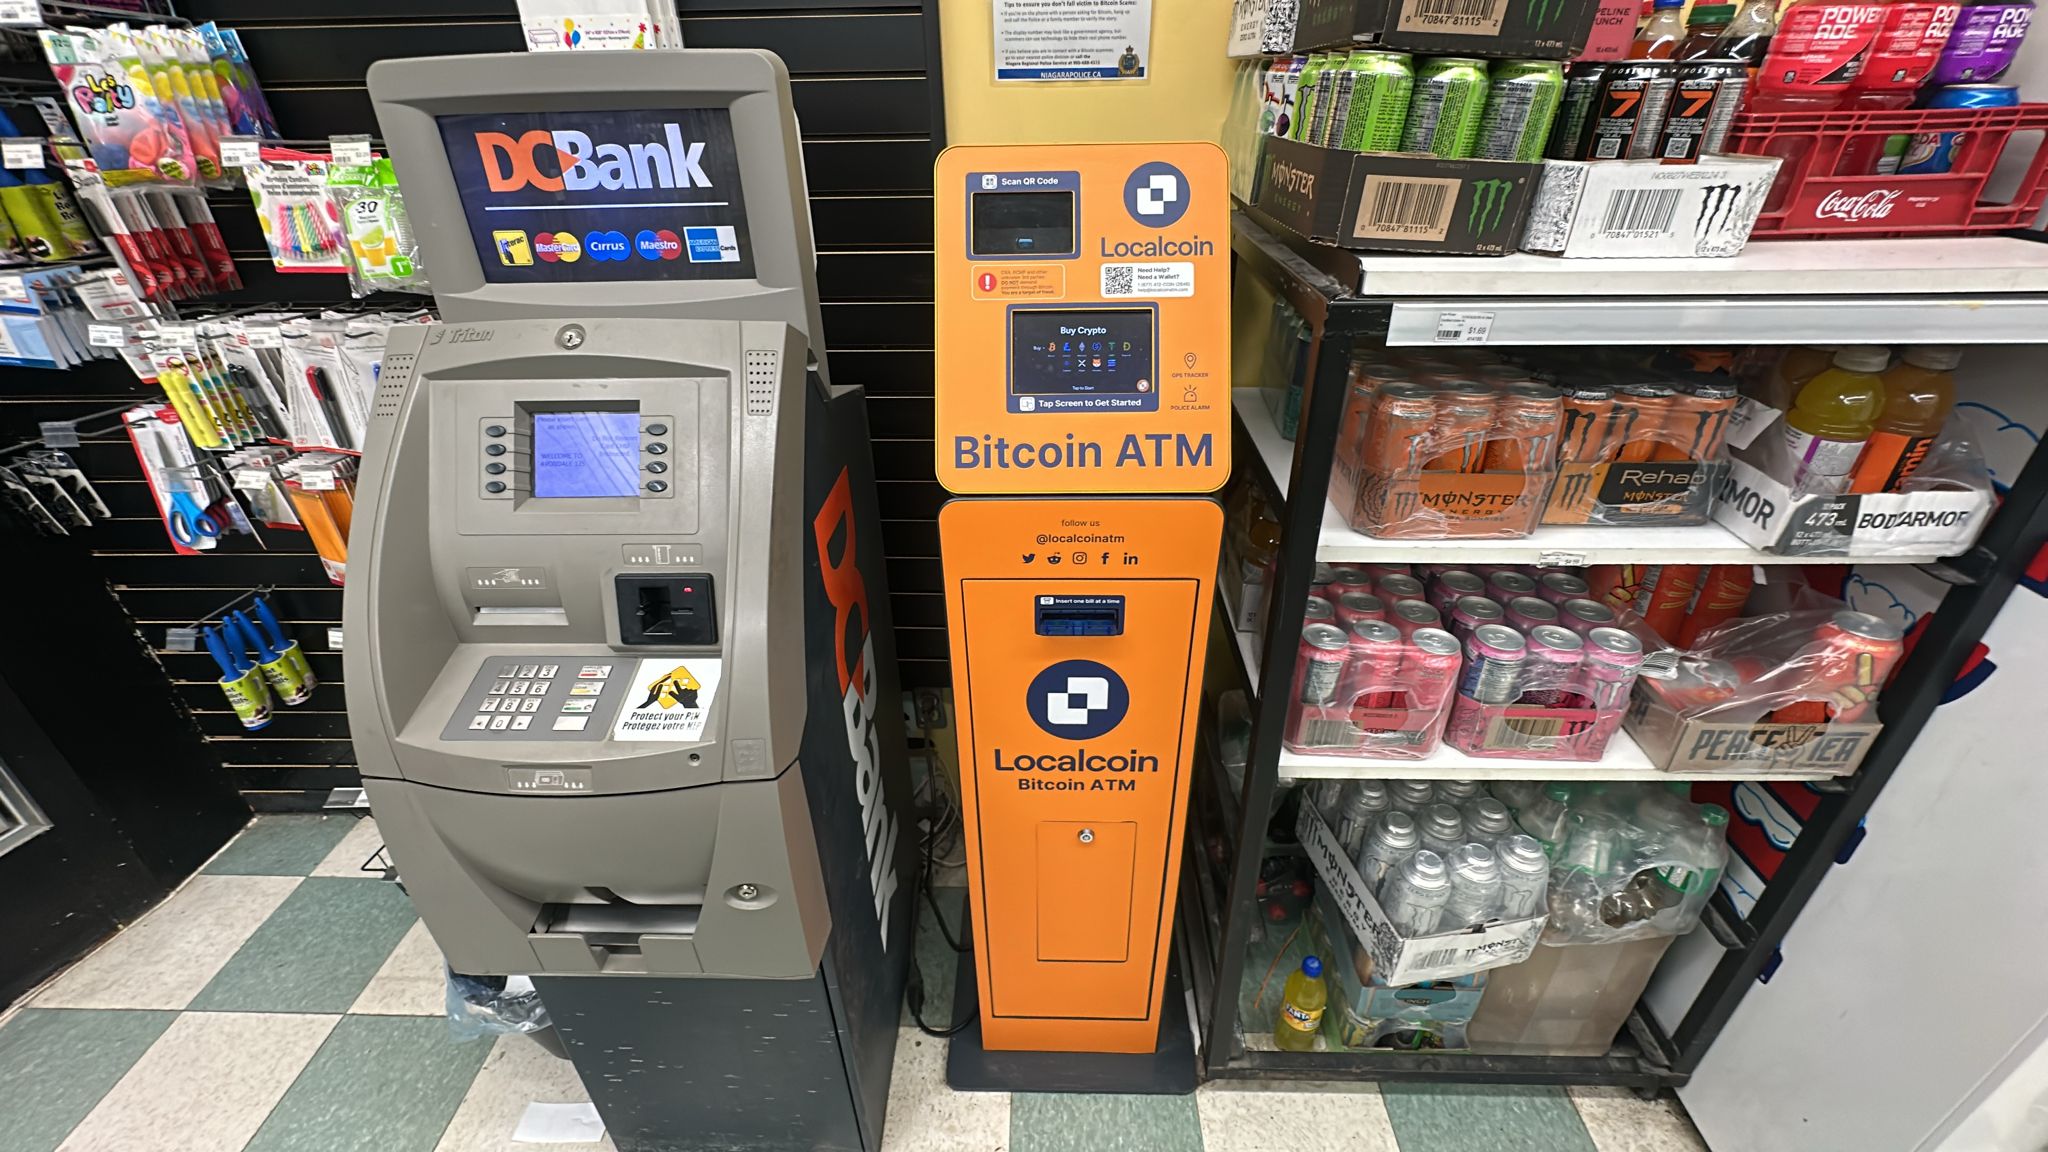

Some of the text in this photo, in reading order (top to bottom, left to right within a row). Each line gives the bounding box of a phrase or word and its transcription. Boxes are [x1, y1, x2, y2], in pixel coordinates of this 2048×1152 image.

[1422, 14, 1451, 25] 70847
[1452, 15, 1482, 27] 81115
[1814, 24, 1859, 40] ADE
[1041, 71, 1101, 79] NIAGARAPOLICE.CA
[73, 85, 136, 115] Party
[1610, 91, 1642, 118] 7
[1681, 91, 1714, 118] 7
[474, 123, 714, 193] DCBank
[1002, 177, 1059, 186] Scan QR Code
[356, 201, 379, 214] 30
[1815, 189, 1905, 219] Coca-Cola
[1376, 223, 1402, 233] 70847
[1403, 224, 1429, 235] 81115
[1605, 231, 1631, 239] 70847
[1634, 231, 1660, 239] 01521
[536, 242, 581, 254] MasterCard
[590, 241, 625, 252] Cirrus
[640, 240, 678, 251] Maestro
[1101, 235, 1214, 258] Localcoin
[449, 328, 496, 344] Triton
[1060, 327, 1107, 336] Buy Crypto
[1039, 400, 1054, 409] Tap
[1095, 399, 1110, 407] Get
[1111, 399, 1142, 407] Started
[954, 433, 1214, 470] Bitcoin ATM
[1620, 469, 1707, 487] Rehab
[1421, 491, 1528, 507] MONSTER
[1061, 519, 1088, 528] follow
[1805, 512, 1839, 527] 473
[1036, 534, 1125, 546] @localcoinatm
[543, 669, 551, 677] 3
[486, 702, 534, 711] 7 8 9
[813, 464, 898, 954] DCBank
[630, 712, 663, 721] Protect
[664, 713, 685, 721] your
[496, 720, 503, 728] 0
[662, 722, 685, 731] votre
[1689, 730, 1871, 762] PEACE TEA
[994, 749, 1159, 773] Localcoin
[1018, 779, 1136, 791] Bitcoin ATM
